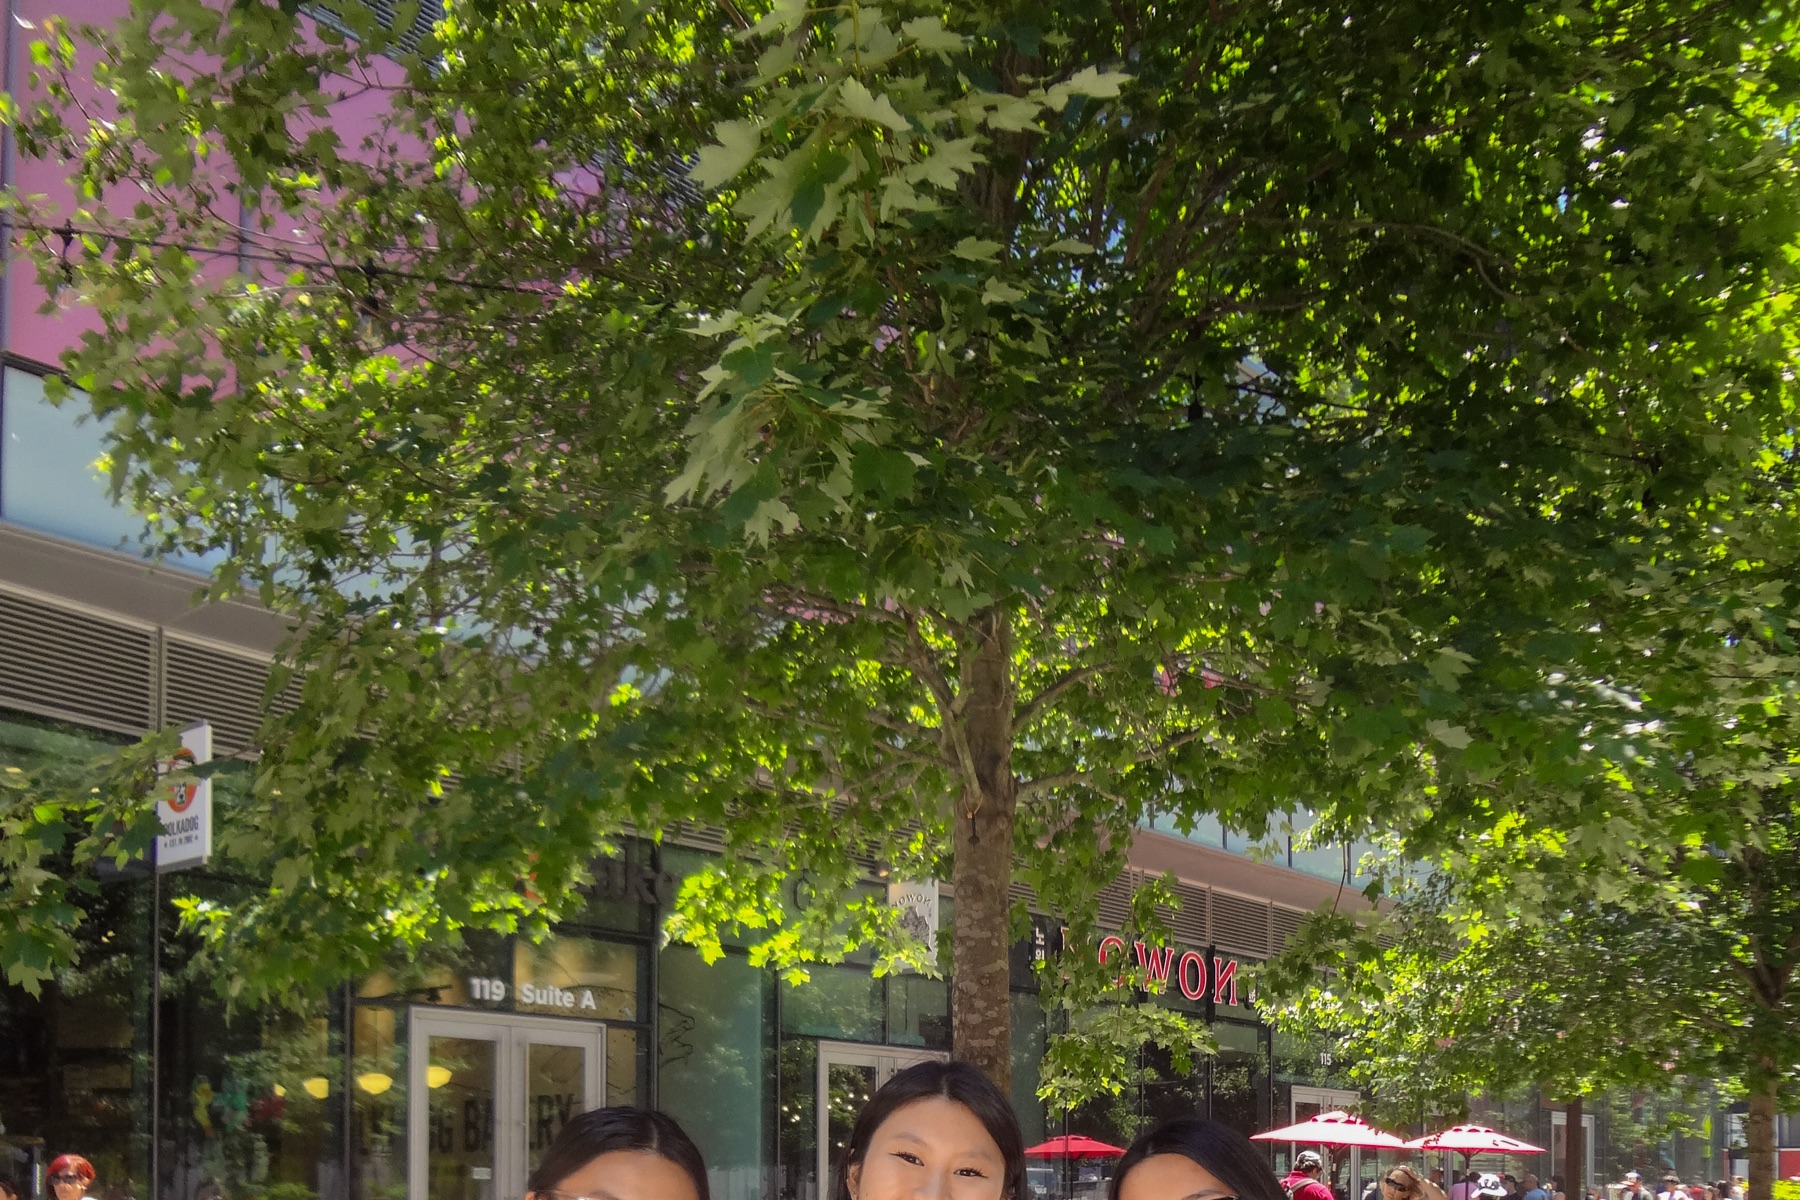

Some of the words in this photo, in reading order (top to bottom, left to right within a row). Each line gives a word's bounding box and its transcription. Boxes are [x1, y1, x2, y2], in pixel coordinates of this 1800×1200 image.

[1060, 926, 1238, 1007] OWON
[469, 977, 506, 1002] 119
[521, 983, 575, 1008] Suite
[580, 989, 597, 1010] A
[1320, 1052, 1332, 1066] 115
